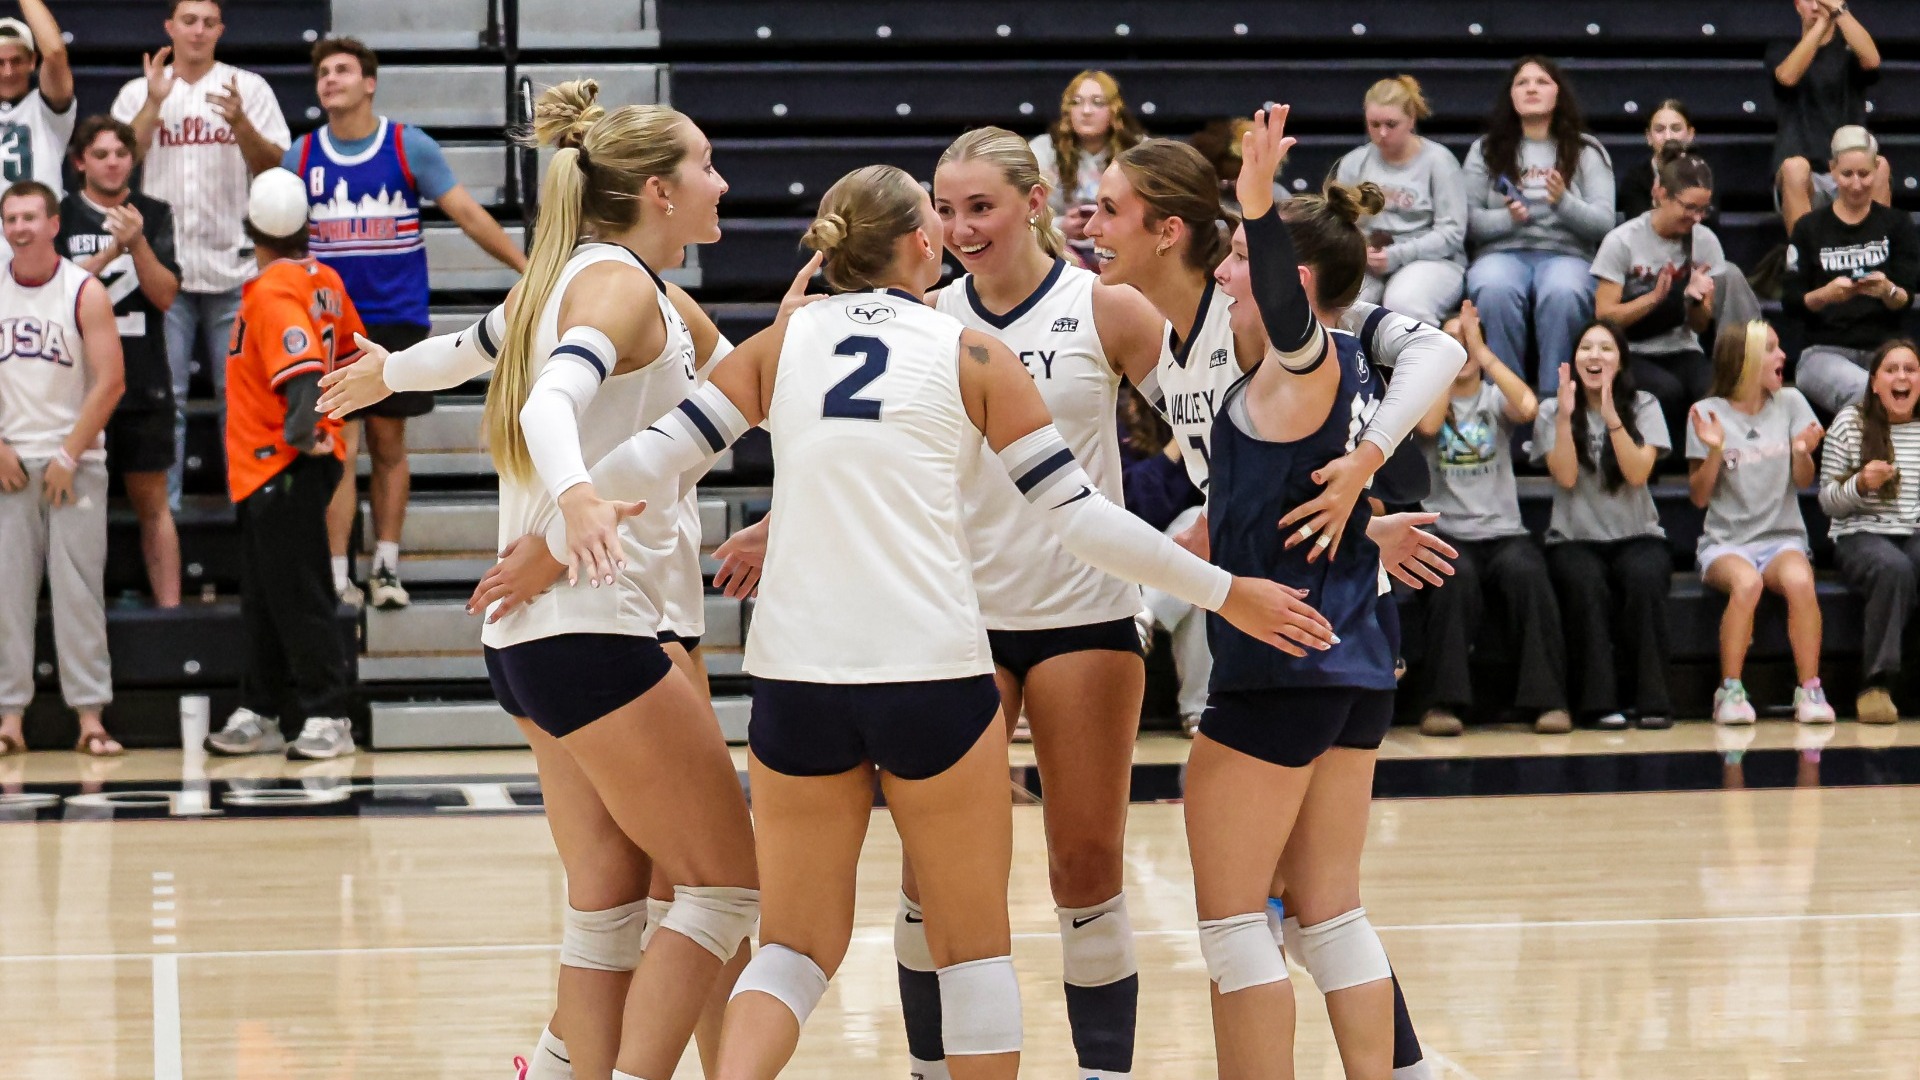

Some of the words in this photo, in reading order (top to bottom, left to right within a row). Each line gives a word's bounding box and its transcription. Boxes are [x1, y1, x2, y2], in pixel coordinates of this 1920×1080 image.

[158, 115, 236, 147] hillies
[821, 334, 892, 421] 2
[1171, 389, 1215, 425] VALLEY
